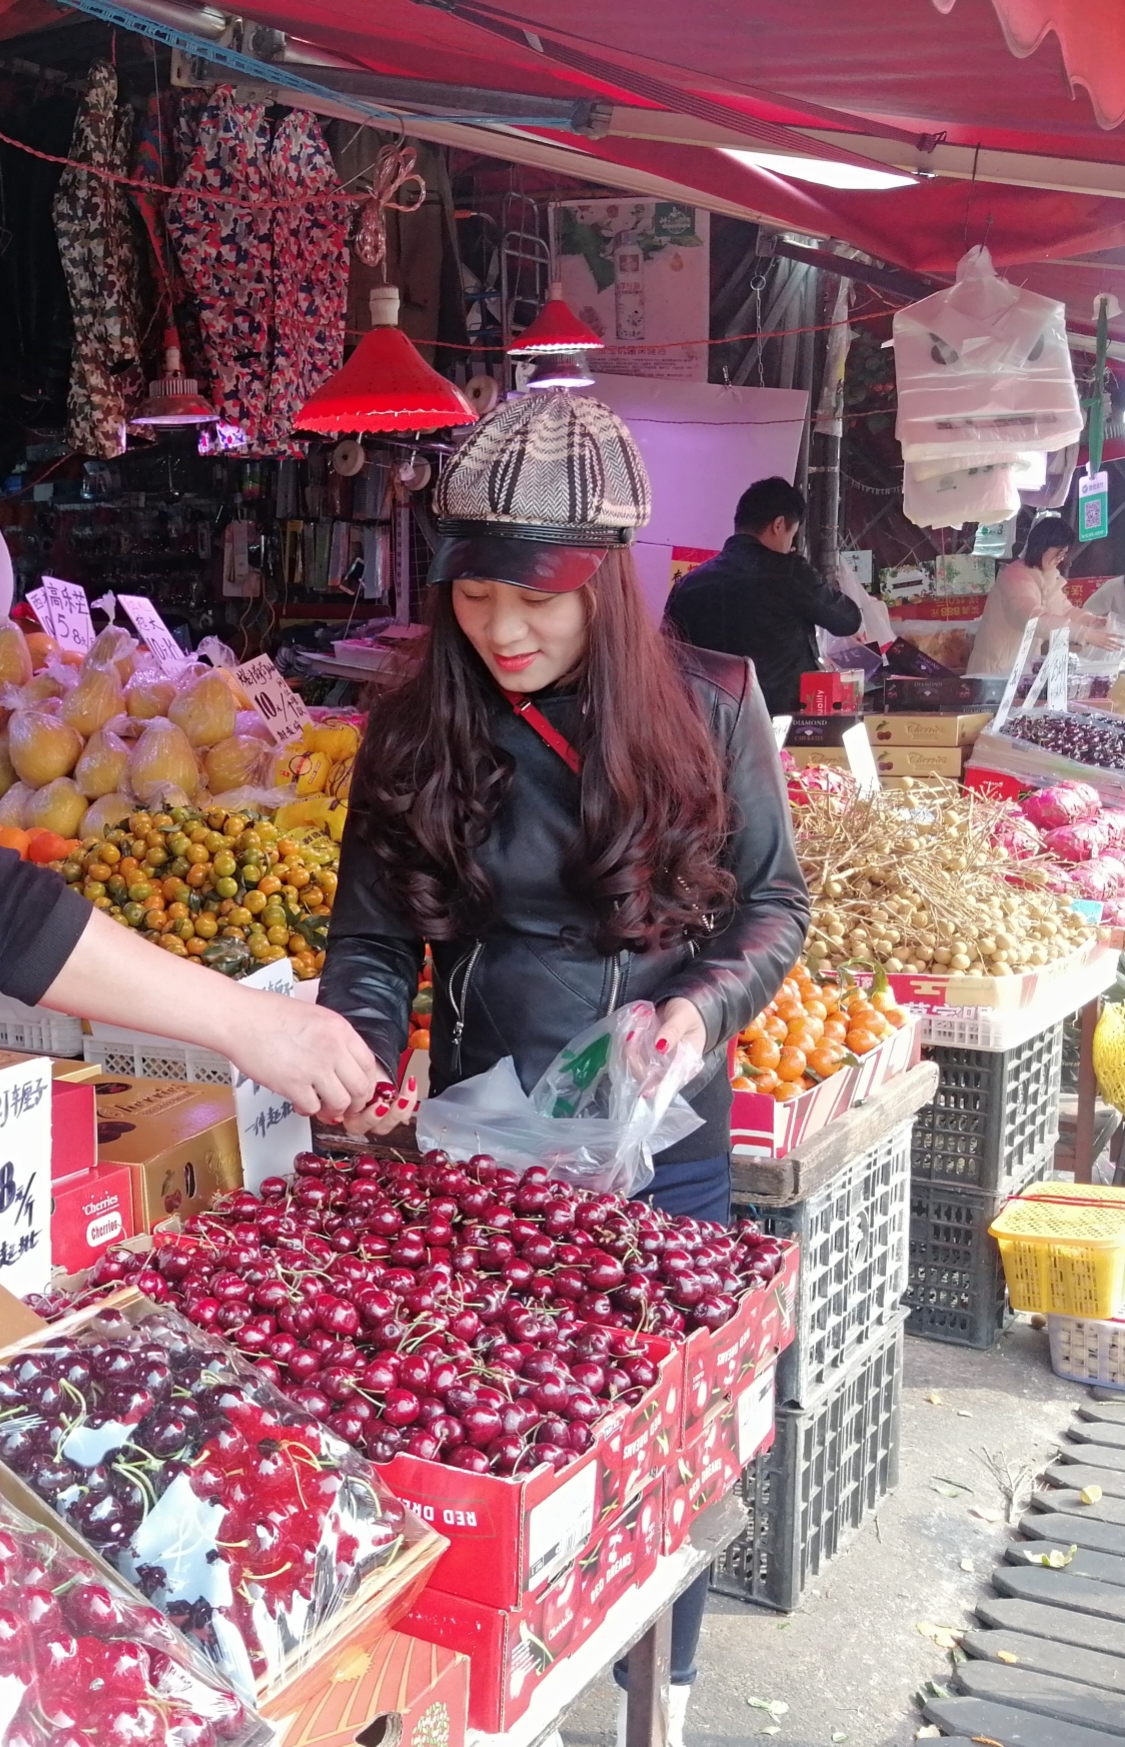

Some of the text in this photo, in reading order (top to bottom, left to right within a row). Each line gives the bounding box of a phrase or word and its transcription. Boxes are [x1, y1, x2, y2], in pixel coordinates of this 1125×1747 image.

[84, 1194, 119, 1216] Cherries
[91, 1219, 118, 1240] Cherries
[717, 1327, 751, 1367] RED DREAMS
[623, 1411, 663, 1460] RED DREAMS
[688, 1458, 722, 1501] RED DREAMS
[443, 1509, 478, 1527] RED
[590, 1552, 632, 1605] RED DREAMS
